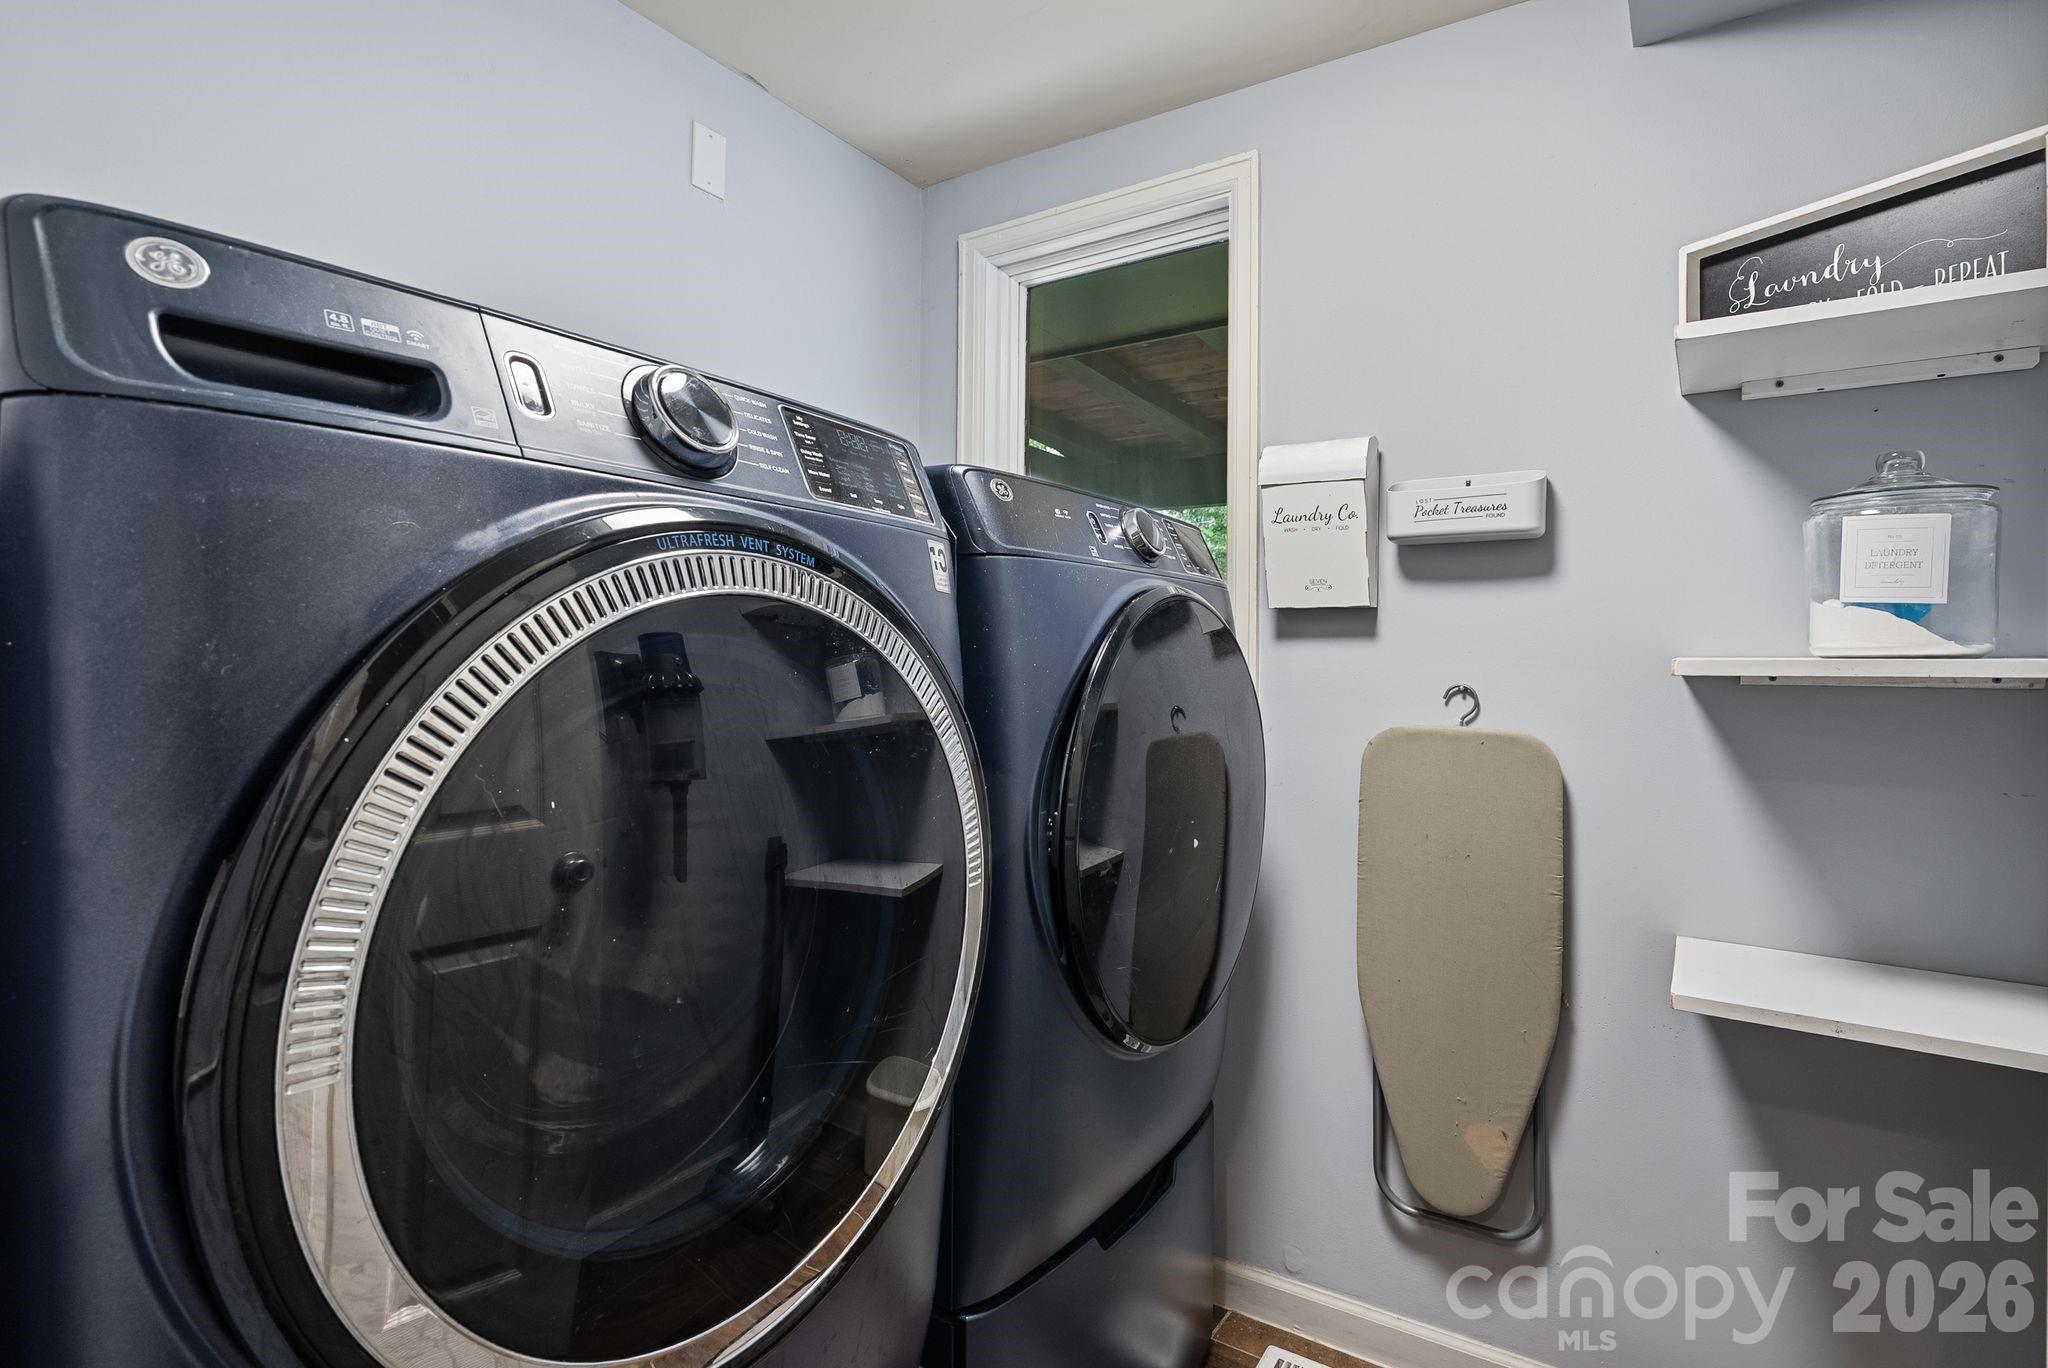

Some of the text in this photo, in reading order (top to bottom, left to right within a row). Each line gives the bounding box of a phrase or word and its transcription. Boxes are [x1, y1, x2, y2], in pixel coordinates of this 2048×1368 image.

[1729, 243, 1882, 313] Laundry
[329, 313, 349, 323] 4.8
[751, 400, 767, 409] WASH
[743, 411, 772, 425] DELICATES
[772, 466, 790, 475] CLEAN
[1271, 503, 1359, 526] Laundry Co.
[1414, 501, 1508, 518] Pocket Treasures
[656, 532, 815, 568] ULTRAFRESH VENT SYSTEM
[1870, 548, 1919, 557] LAUNDRY
[1864, 561, 1924, 569] DETERGENT
